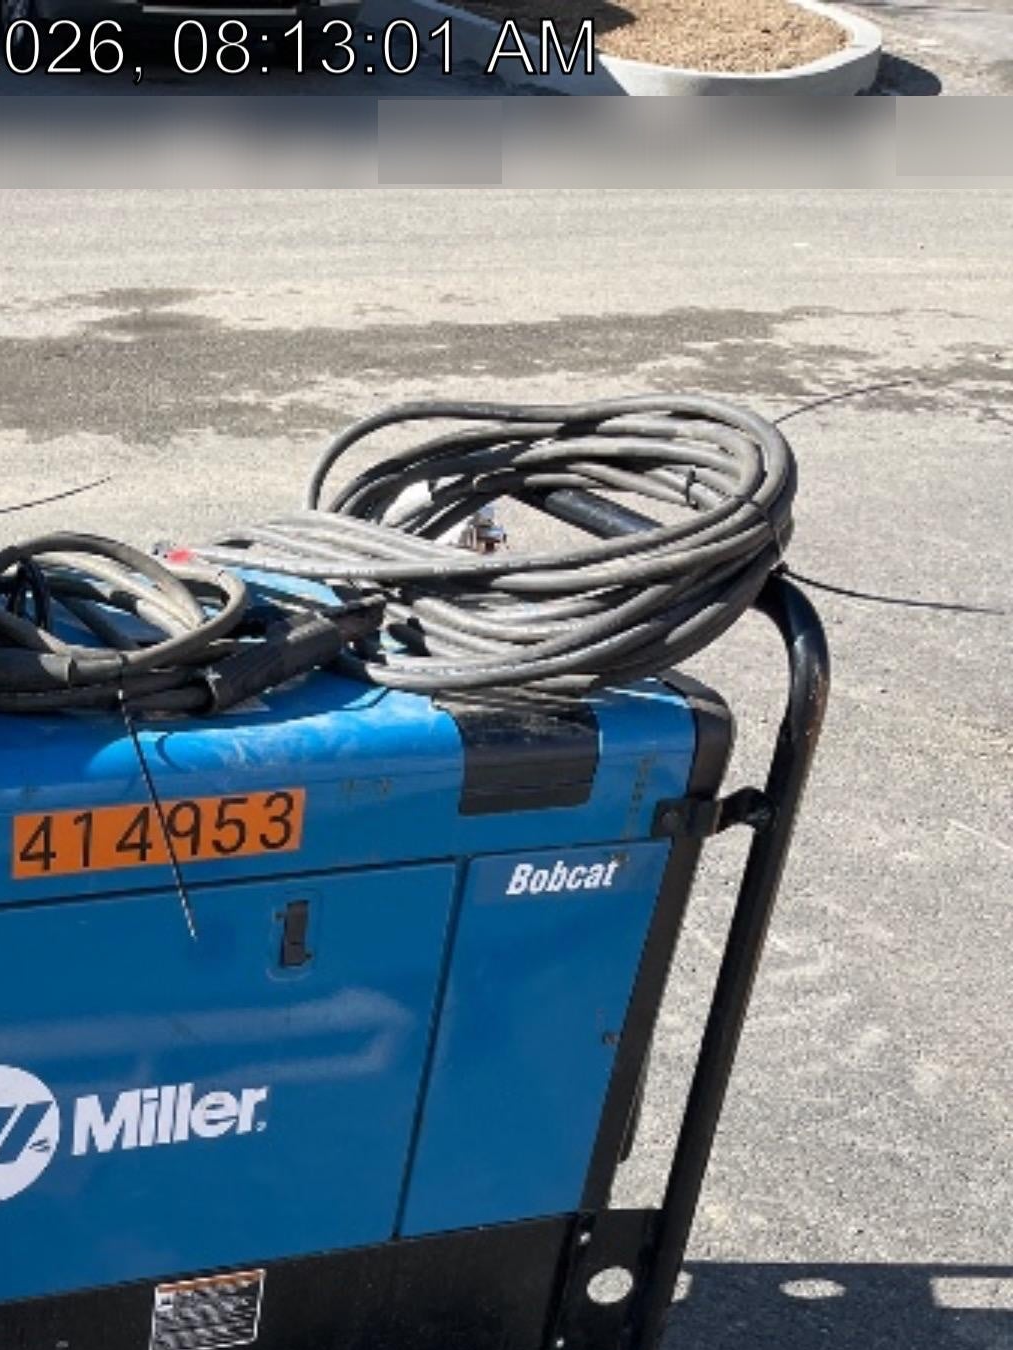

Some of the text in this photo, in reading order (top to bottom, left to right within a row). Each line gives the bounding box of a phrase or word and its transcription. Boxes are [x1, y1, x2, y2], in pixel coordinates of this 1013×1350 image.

[19, 791, 294, 871] 414953
[506, 860, 619, 895] Bobcat
[71, 1083, 268, 1156] Miller
